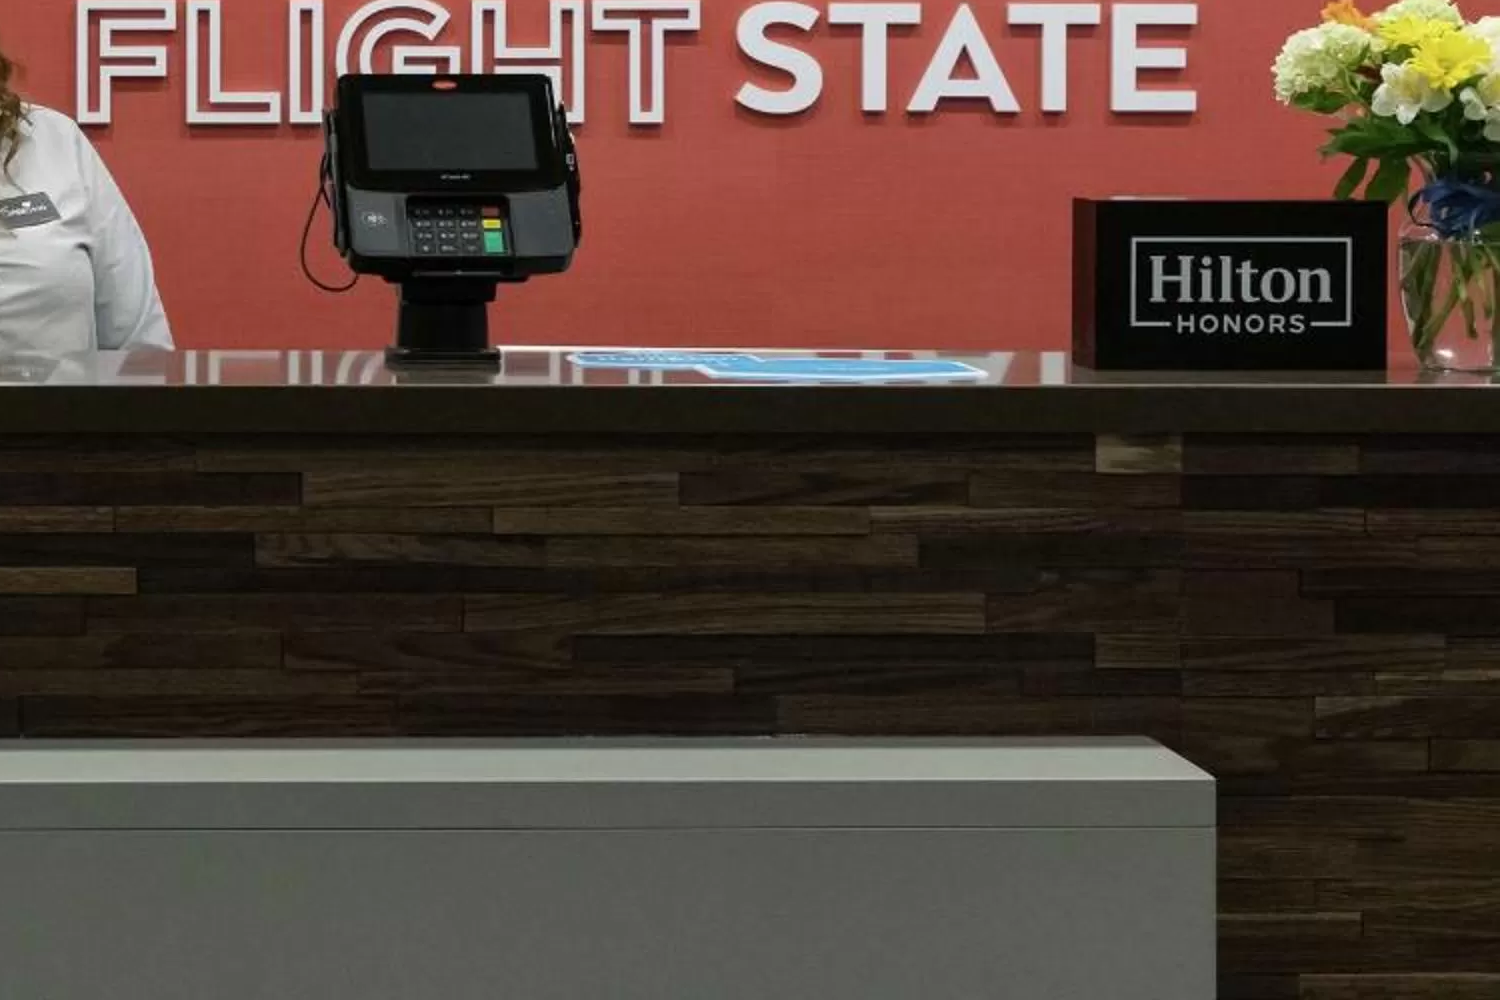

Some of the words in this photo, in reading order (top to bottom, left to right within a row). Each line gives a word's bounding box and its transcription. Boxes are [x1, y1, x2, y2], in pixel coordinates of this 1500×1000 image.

[734, 1, 1198, 115] STATE
[1149, 255, 1333, 303] Hilton
[1177, 313, 1306, 334] HONORS
